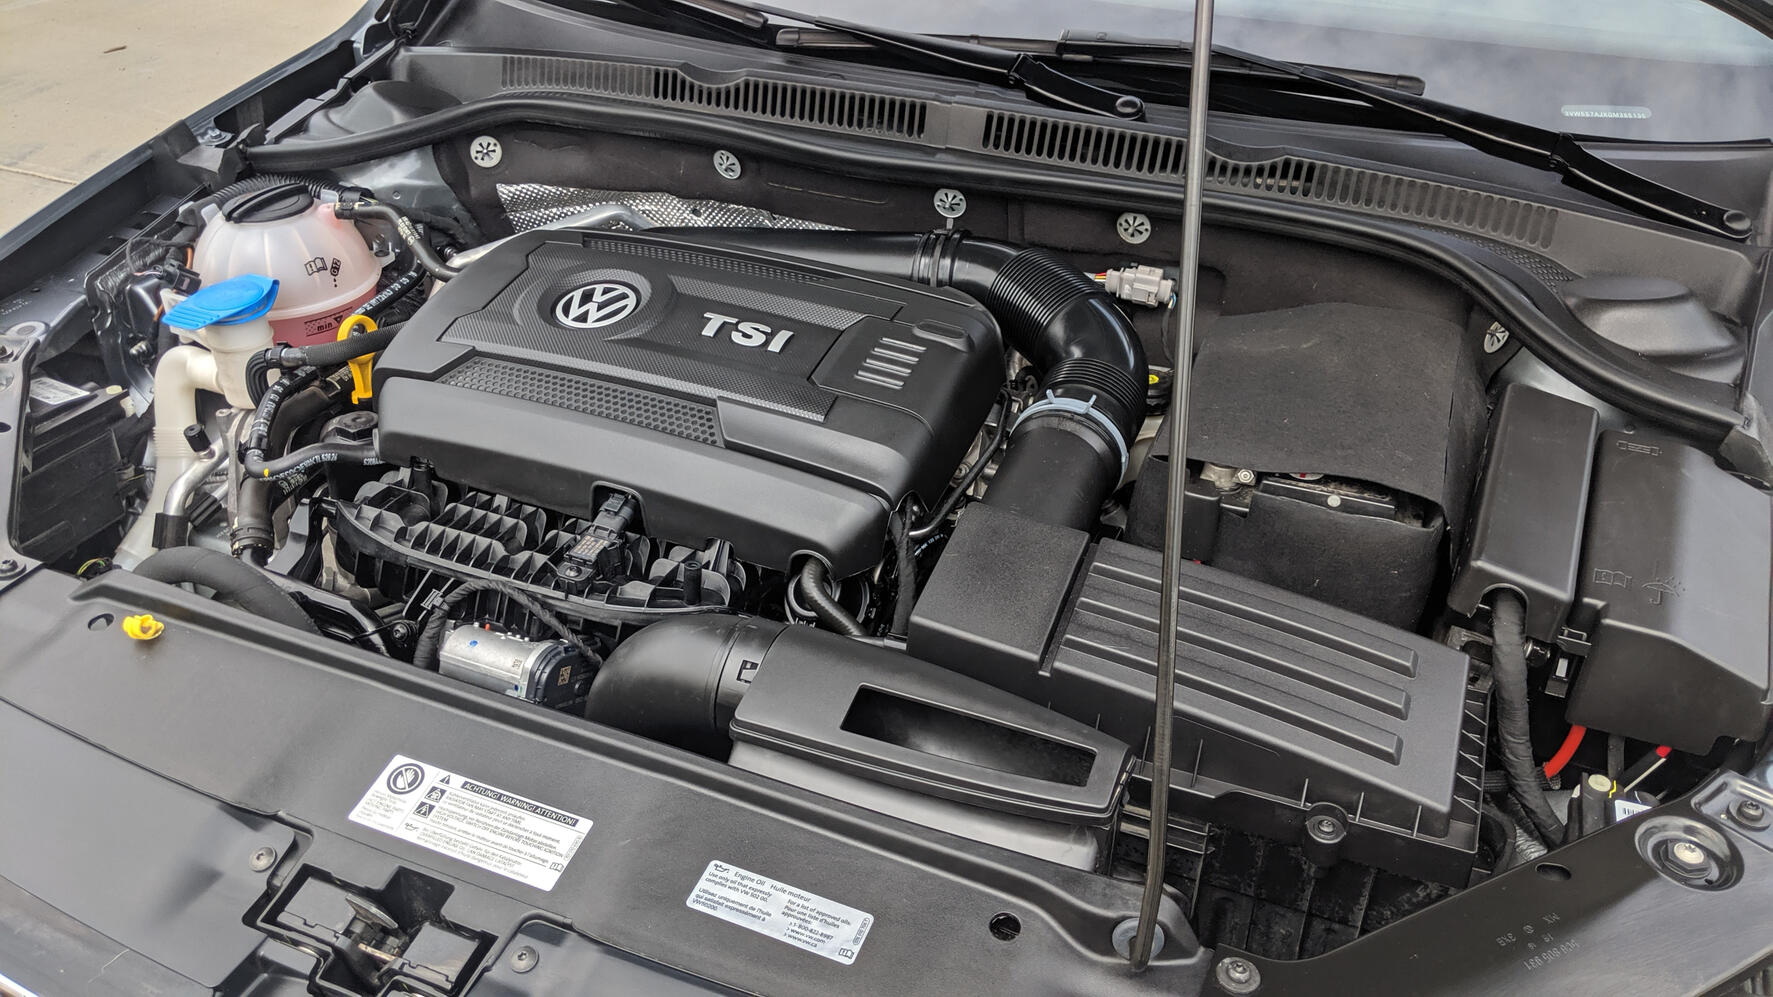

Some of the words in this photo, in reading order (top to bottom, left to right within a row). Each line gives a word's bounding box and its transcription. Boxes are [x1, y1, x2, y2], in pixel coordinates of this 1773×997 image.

[317, 322, 333, 332] min
[701, 312, 795, 353] TSI
[464, 783, 500, 799] ACHTUNG!
[500, 796, 536, 812] WARNING!
[535, 807, 576, 825] ATTENTION!
[704, 876, 727, 888] complies
[726, 884, 740, 892] with
[733, 871, 756, 883] Engine
[754, 878, 766, 886] Oil
[769, 884, 788, 894] Huile
[786, 890, 811, 902] moteur
[747, 885, 772, 897] expressly
[807, 913, 819, 921] liste
[814, 909, 841, 922] approved
